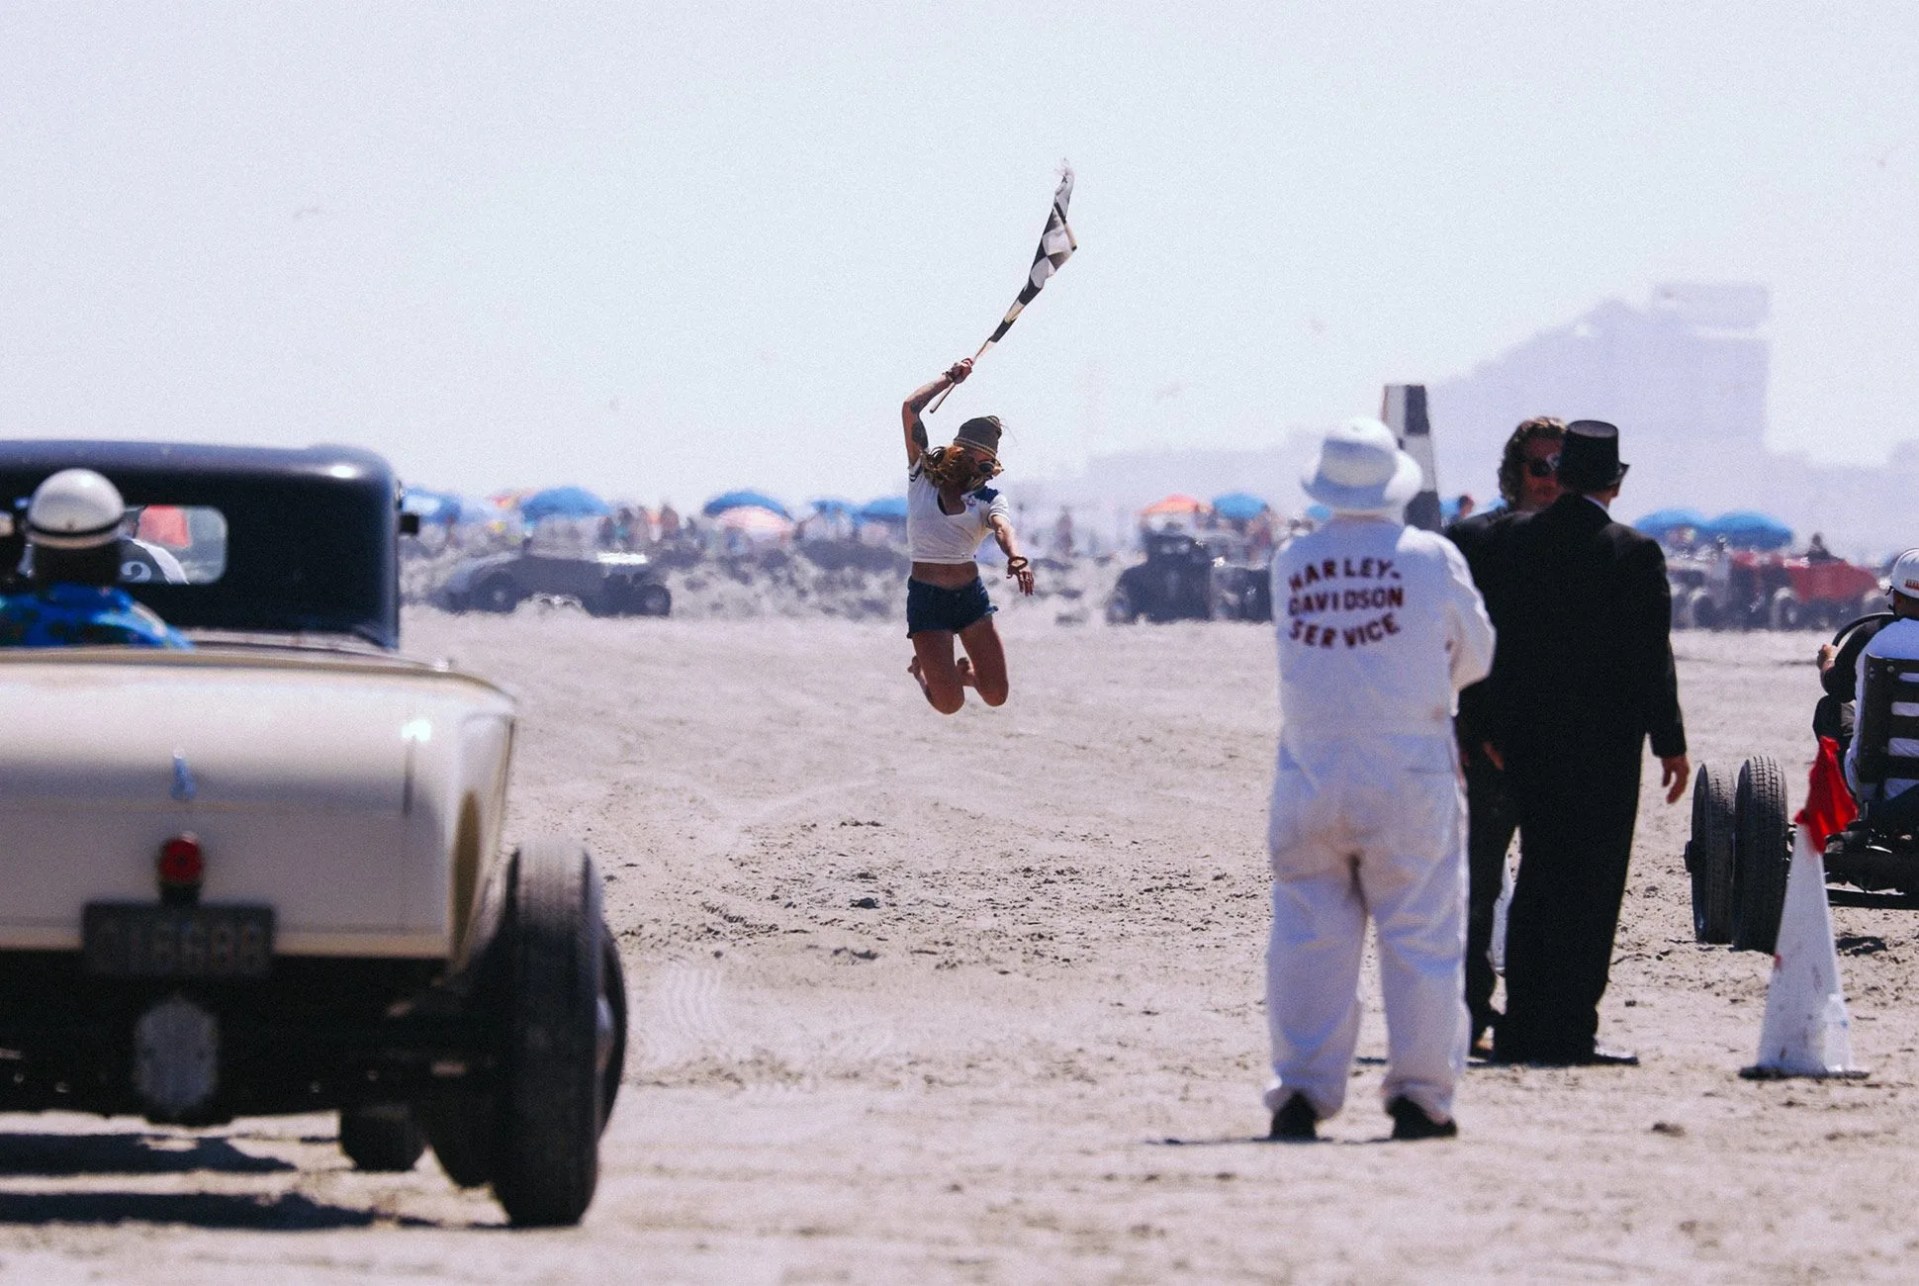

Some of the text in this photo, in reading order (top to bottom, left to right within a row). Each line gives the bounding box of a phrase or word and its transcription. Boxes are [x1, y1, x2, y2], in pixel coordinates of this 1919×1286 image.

[1289, 558, 1400, 591] HARLEY-
[1288, 587, 1403, 616] DAVIDSON
[1289, 613, 1400, 648] SERVICE
